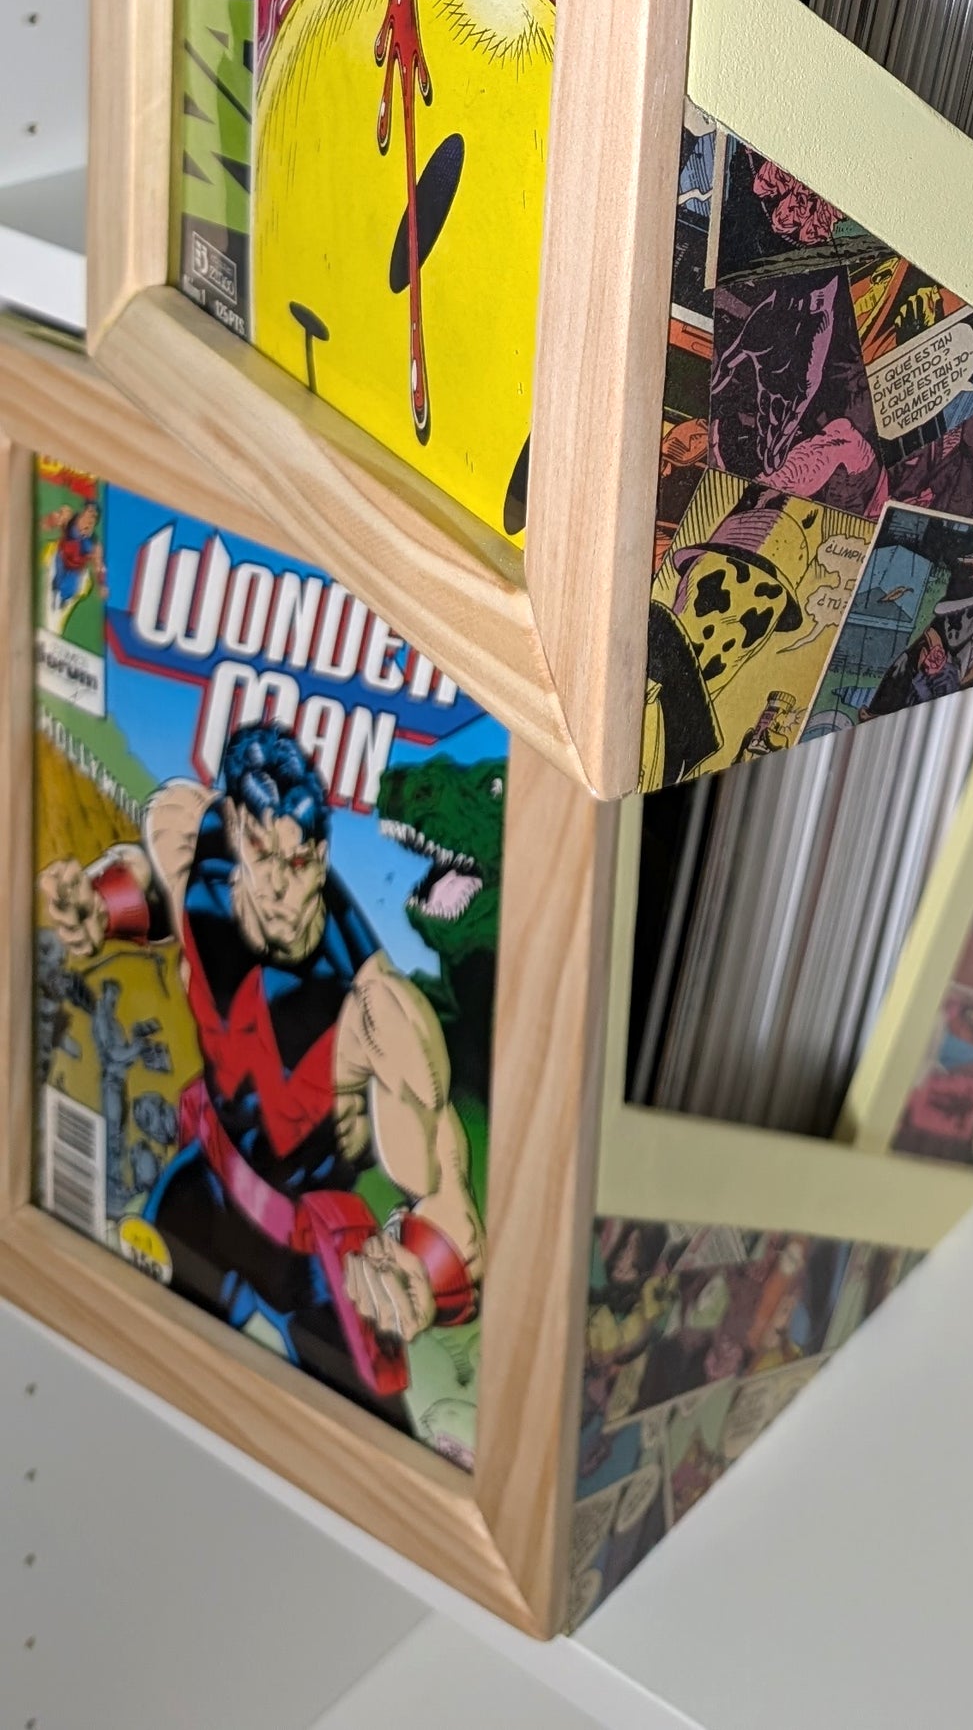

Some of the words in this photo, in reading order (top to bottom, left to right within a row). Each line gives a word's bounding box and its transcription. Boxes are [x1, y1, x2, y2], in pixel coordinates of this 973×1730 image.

[914, 349, 930, 364] ES
[930, 333, 953, 352] TAN
[917, 376, 932, 390] ES
[932, 362, 953, 379] TAN
[954, 350, 973, 367] JO-
[882, 380, 950, 428] DIDAMENTE
[951, 367, 968, 383] DI-
[200, 660, 397, 807] MAN
